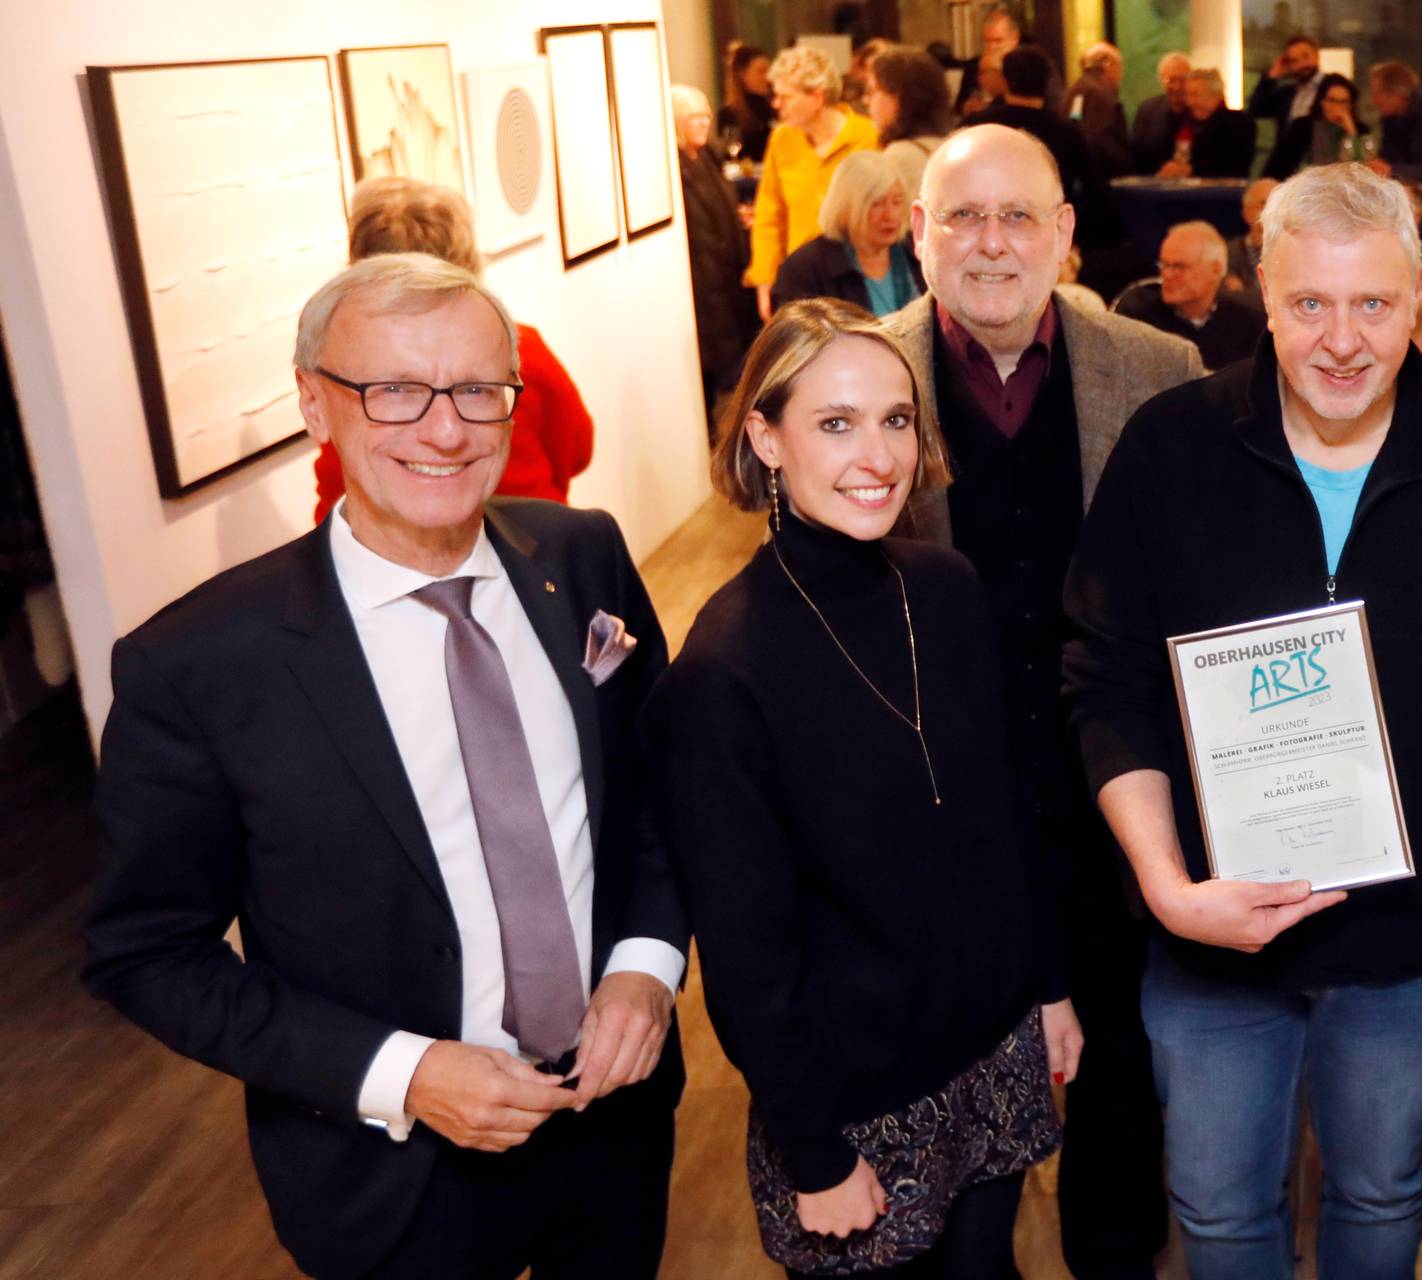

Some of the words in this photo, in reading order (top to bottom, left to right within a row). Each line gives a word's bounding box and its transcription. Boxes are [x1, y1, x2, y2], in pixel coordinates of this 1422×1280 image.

[1194, 636, 1308, 669] OBERHAUSEN
[1310, 628, 1346, 648] CITY
[1250, 646, 1330, 713] ARTS
[1308, 692, 1332, 708] 2023
[1261, 718, 1310, 734] URKUNDE
[1212, 750, 1242, 760] MALEREI
[1248, 743, 1274, 753] GRAFIK
[1280, 733, 1323, 748] FOTOGRAFIE
[1329, 726, 1365, 738] SKULPTUR
[1276, 775, 1283, 786] 2.
[1286, 770, 1314, 783] PLATZ
[1264, 785, 1295, 800] KLAUS
[1296, 780, 1330, 793] WIESEL
